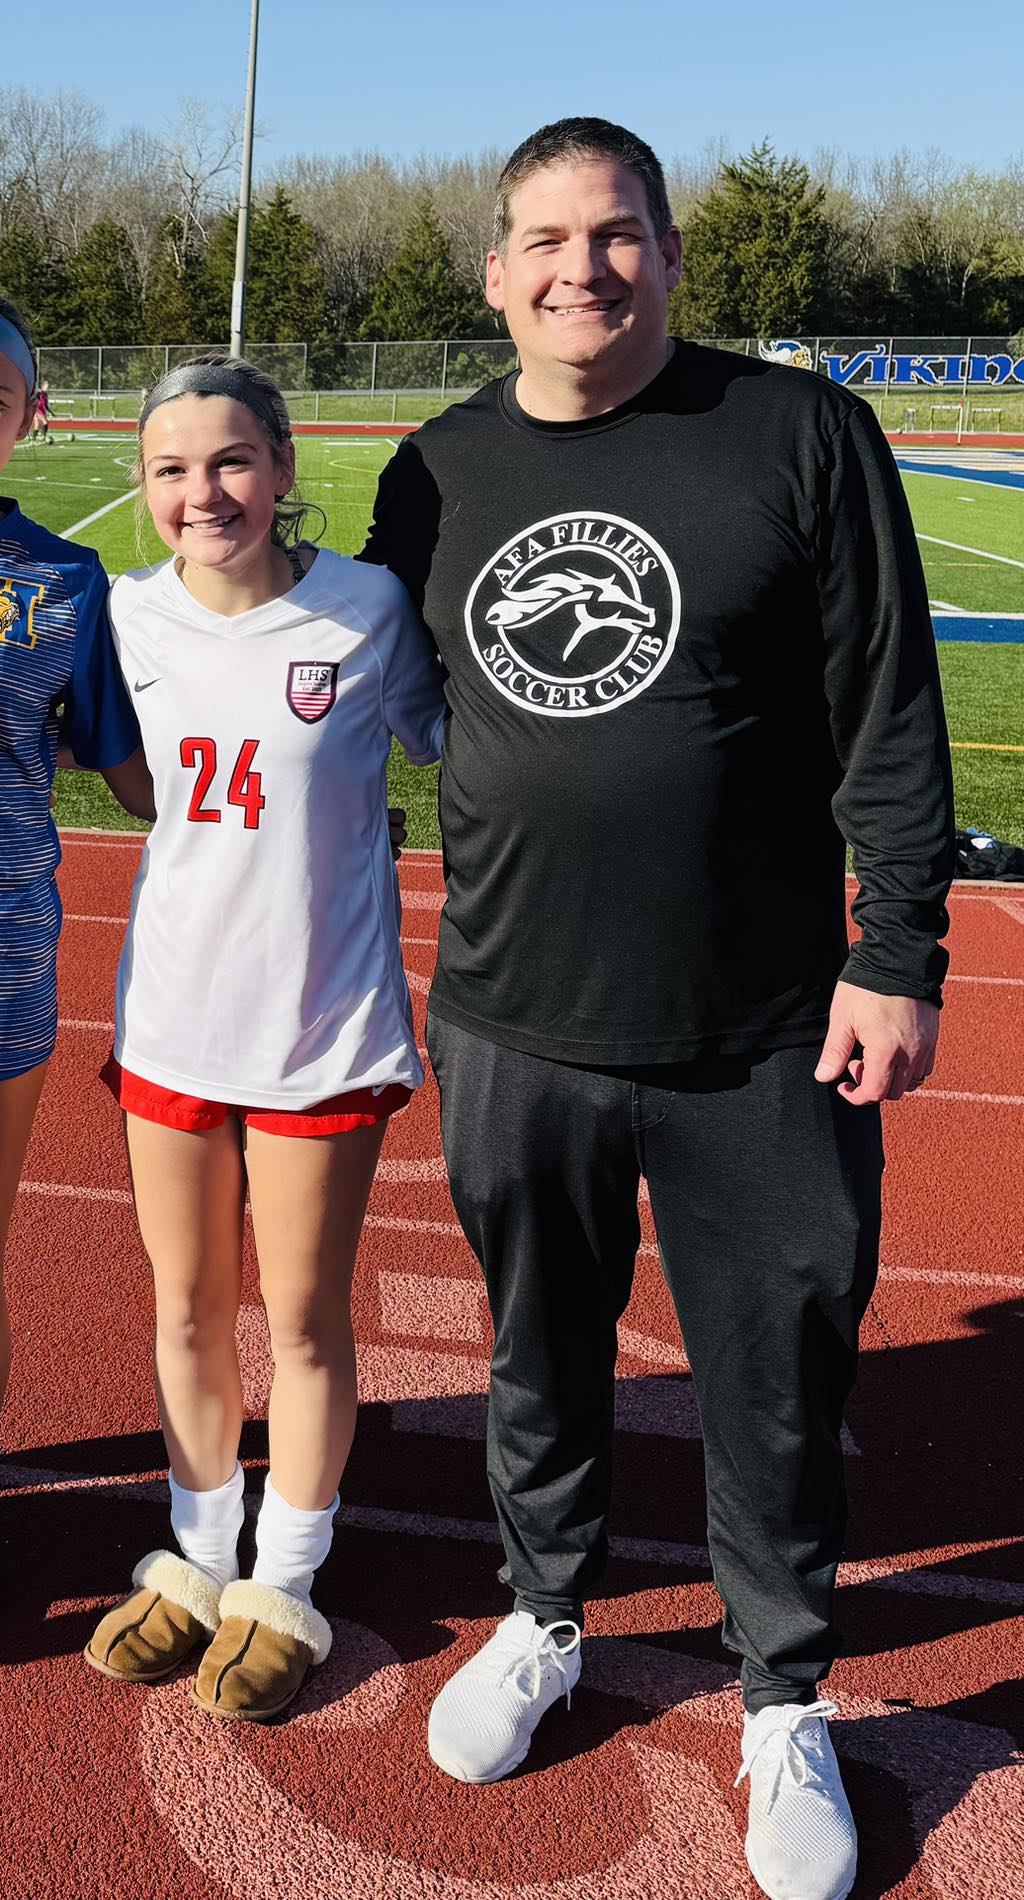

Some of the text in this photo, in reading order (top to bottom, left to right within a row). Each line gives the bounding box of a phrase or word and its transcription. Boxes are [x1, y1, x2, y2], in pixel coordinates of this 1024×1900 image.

[494, 521, 658, 586] AFA FILLIES
[298, 669, 329, 681] LHS
[482, 634, 663, 707] SOCCER CLUB
[179, 737, 266, 830] 24
